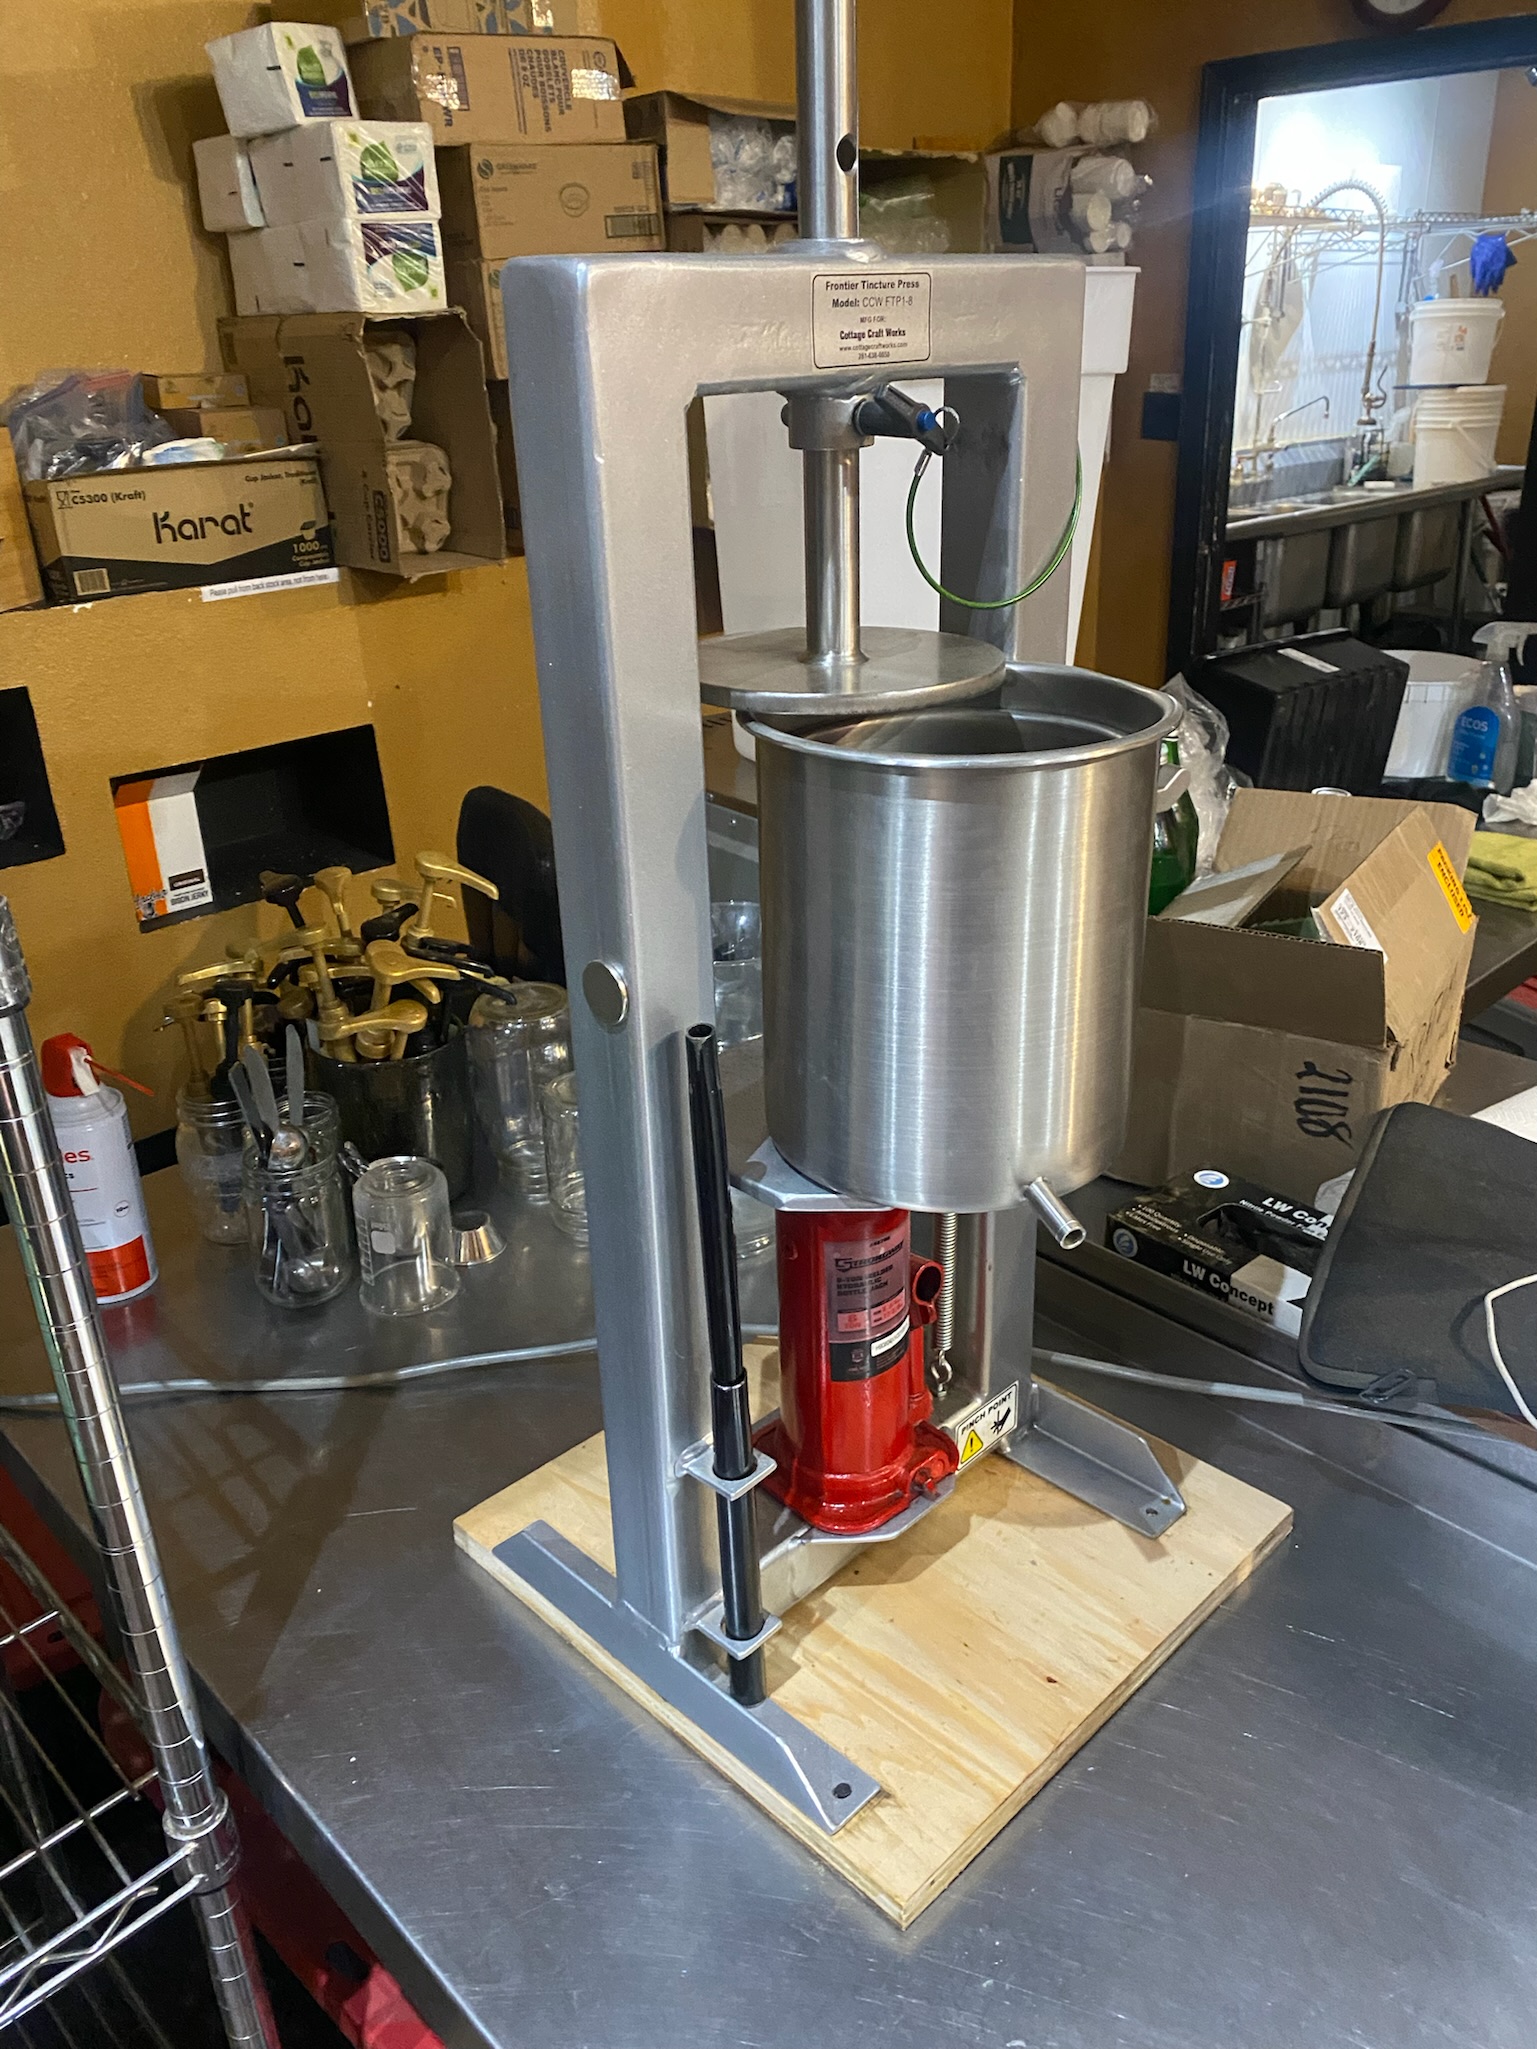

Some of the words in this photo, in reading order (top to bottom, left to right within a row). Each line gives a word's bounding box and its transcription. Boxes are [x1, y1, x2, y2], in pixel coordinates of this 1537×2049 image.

[534, 49, 544, 78] POUR
[527, 49, 539, 98] CHAUDES
[551, 50, 561, 85] BLANC
[557, 88, 565, 115] POUR
[825, 281, 859, 291] Frontier
[861, 280, 895, 290] Tincture
[897, 279, 920, 289] Press
[832, 298, 860, 308] Model:
[862, 296, 883, 307] CCW
[885, 295, 913, 306] FTP1-8
[840, 330, 866, 341] Cottage
[867, 329, 884, 339] Craft
[885, 328, 906, 337] Works
[839, 342, 908, 351] www.cottagecraftworks.com
[111, 490, 147, 504] (Kraft)
[152, 503, 253, 544] Karat
[292, 540, 320, 554] 1000
[209, 588, 227, 597] Please
[227, 586, 238, 595] pull
[303, 575, 315, 583] from
[1461, 716, 1489, 732] ECOS
[1437, 848, 1460, 896] PACKING
[191, 889, 208, 901] JERKY
[1437, 862, 1465, 917] ENCLOSED
[1239, 1199, 1264, 1212] Nitrile
[1264, 1210, 1296, 1225] Powder
[1262, 1196, 1294, 1213] LW
[1154, 1211, 1182, 1228] Quantity
[1183, 1259, 1206, 1280] LW
[1209, 1273, 1274, 1315] Concept
[961, 1410, 986, 1436] PINCH
[987, 1391, 1012, 1415] POINT
